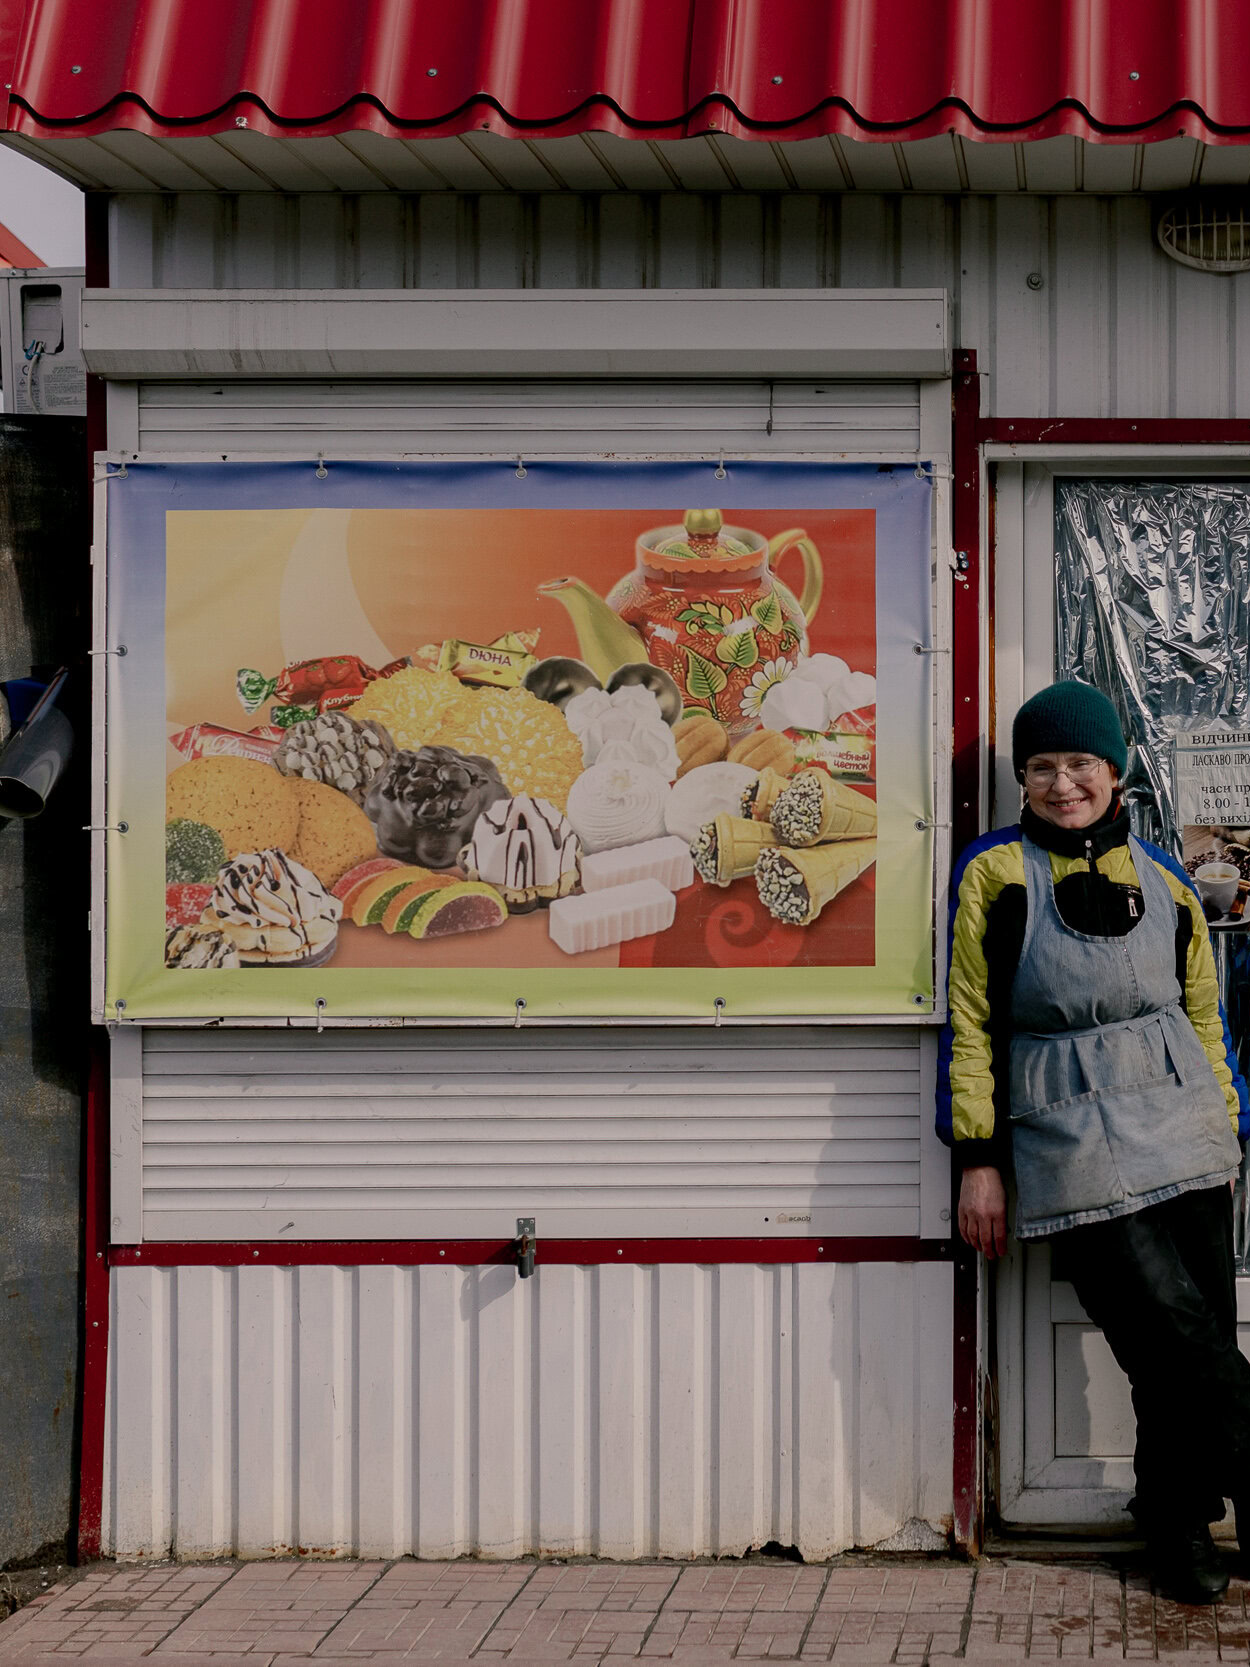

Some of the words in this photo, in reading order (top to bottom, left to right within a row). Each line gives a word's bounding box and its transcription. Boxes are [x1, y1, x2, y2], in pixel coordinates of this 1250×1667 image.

[1192, 753, 1231, 767] ЛАСКАВО
[1201, 785, 1231, 794] часи
[1203, 797, 1231, 809] 8.00
[1194, 814, 1216, 825] без
